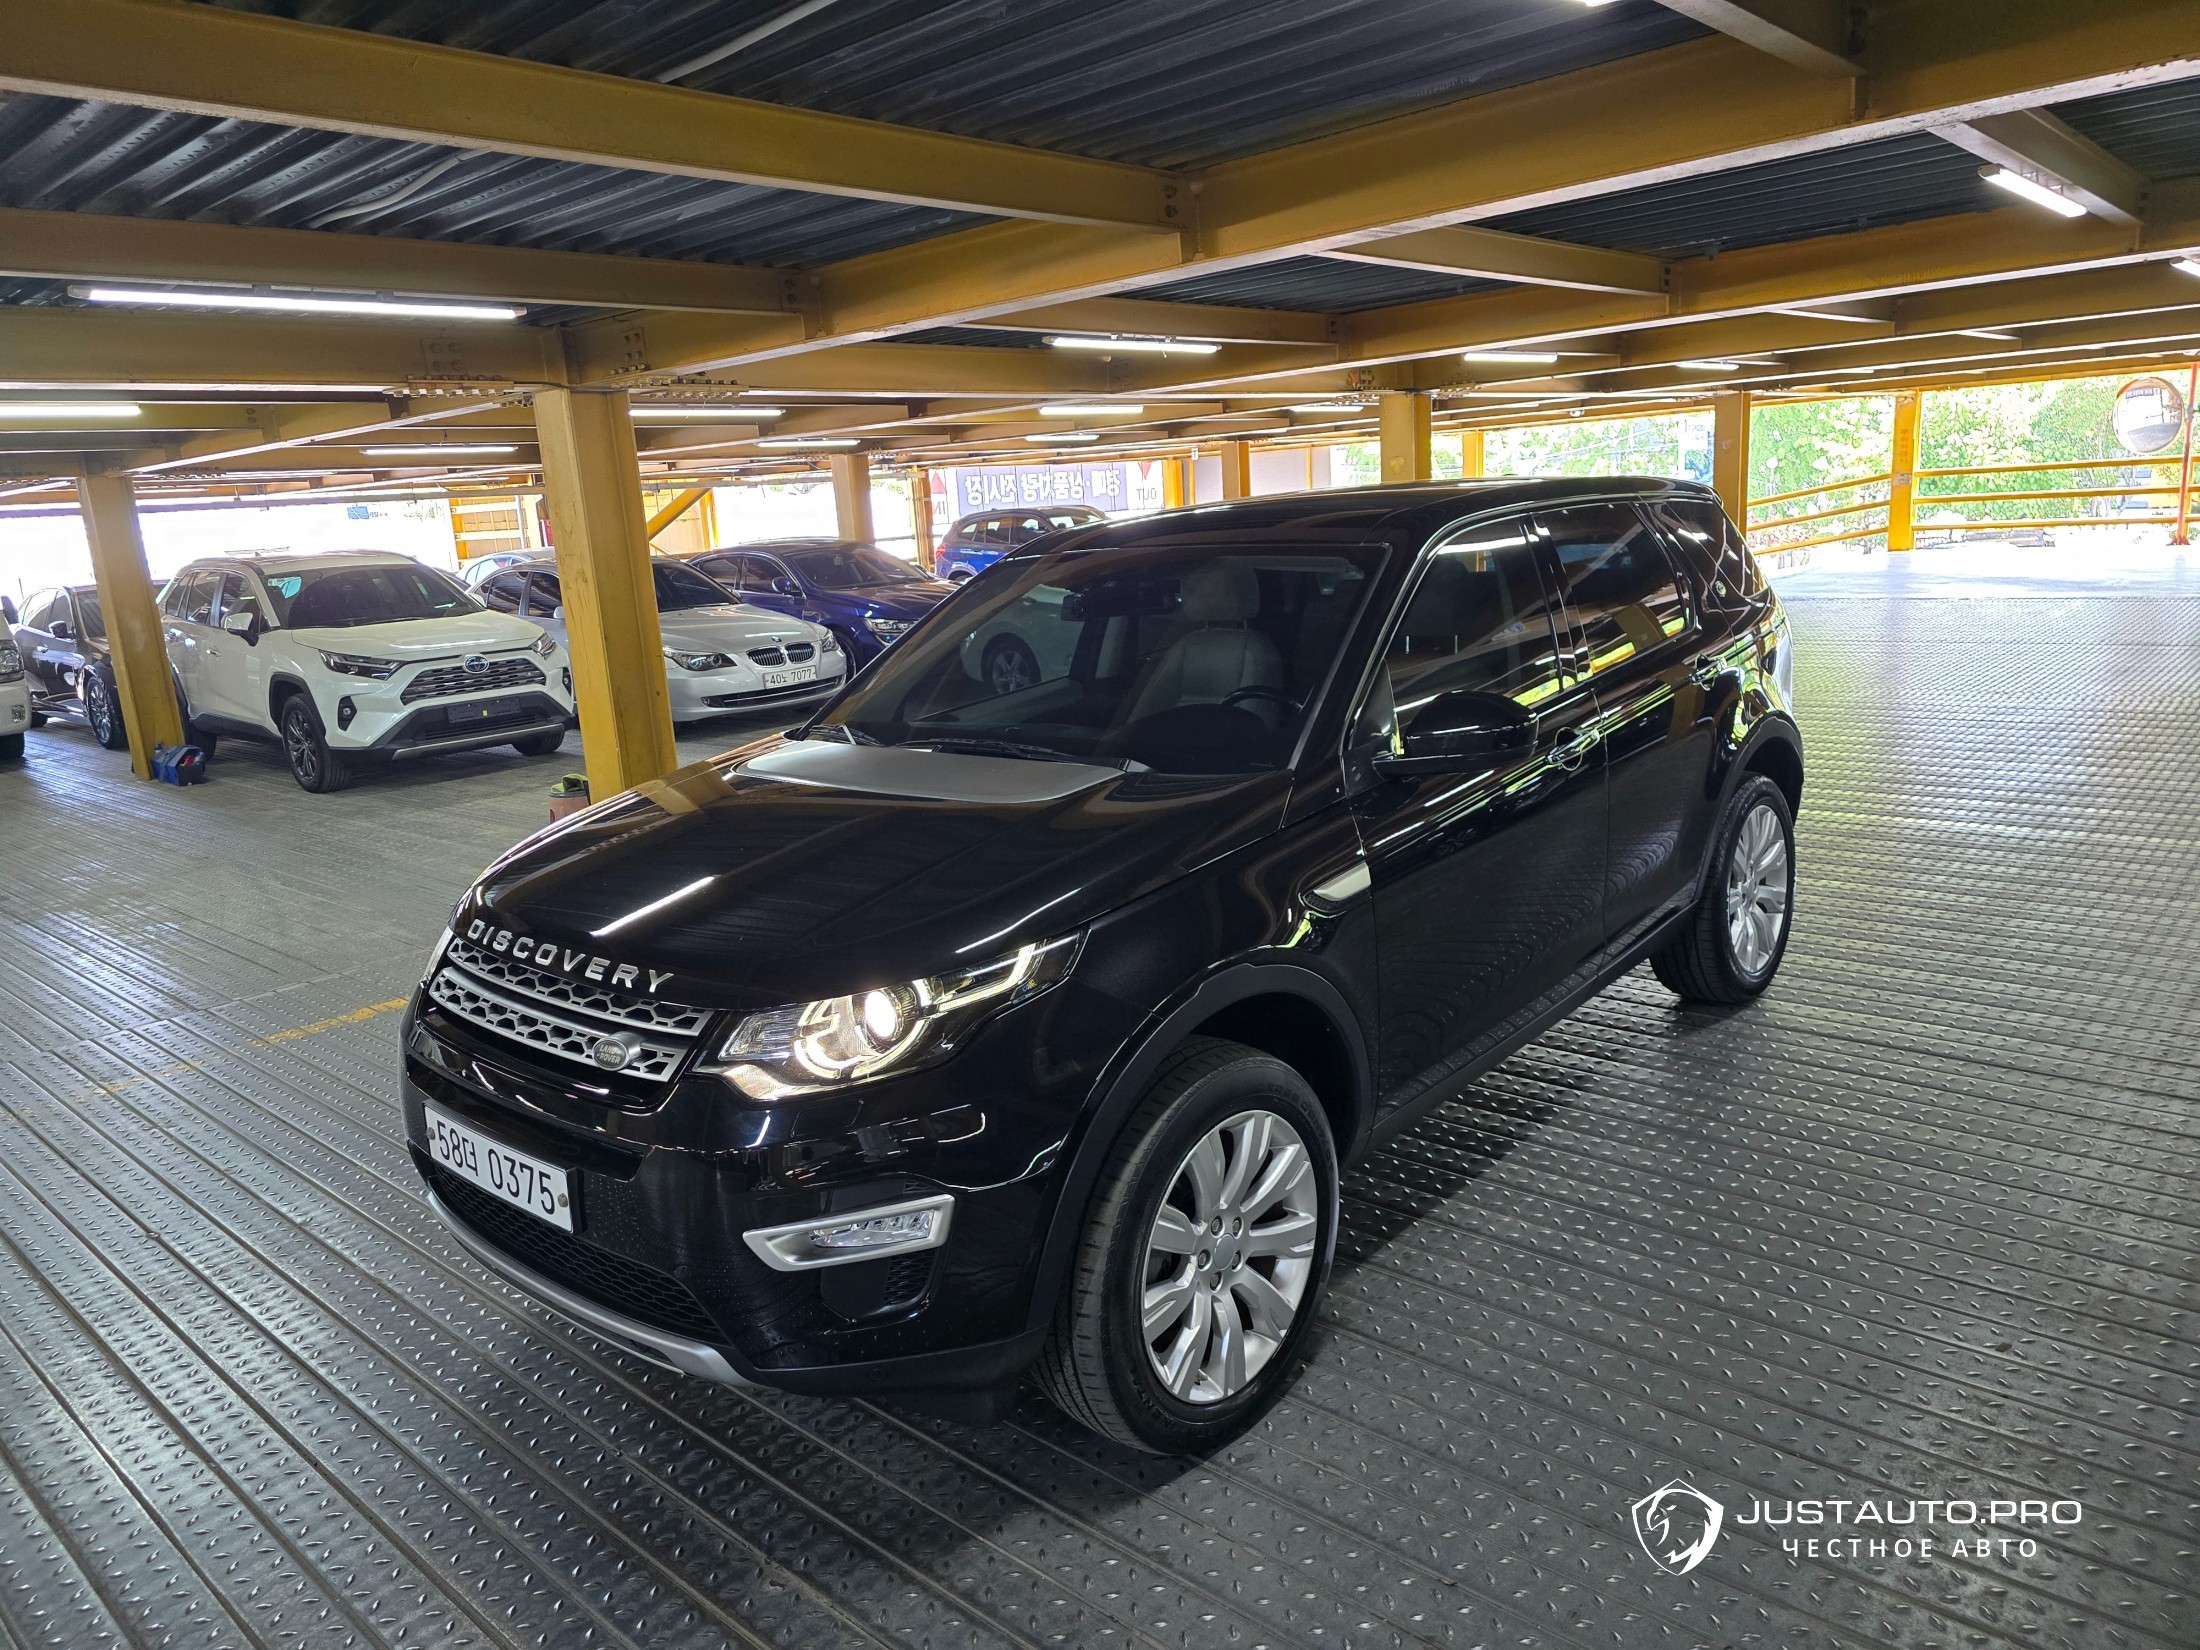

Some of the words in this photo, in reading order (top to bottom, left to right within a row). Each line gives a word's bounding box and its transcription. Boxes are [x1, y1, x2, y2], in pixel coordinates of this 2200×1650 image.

[790, 668, 812, 682] 7077
[467, 918, 675, 993] DISCOVERY
[599, 1044, 617, 1055] LAND
[599, 1052, 621, 1064] ROVER
[436, 1119, 479, 1177] 58더
[487, 1148, 556, 1215] 0375
